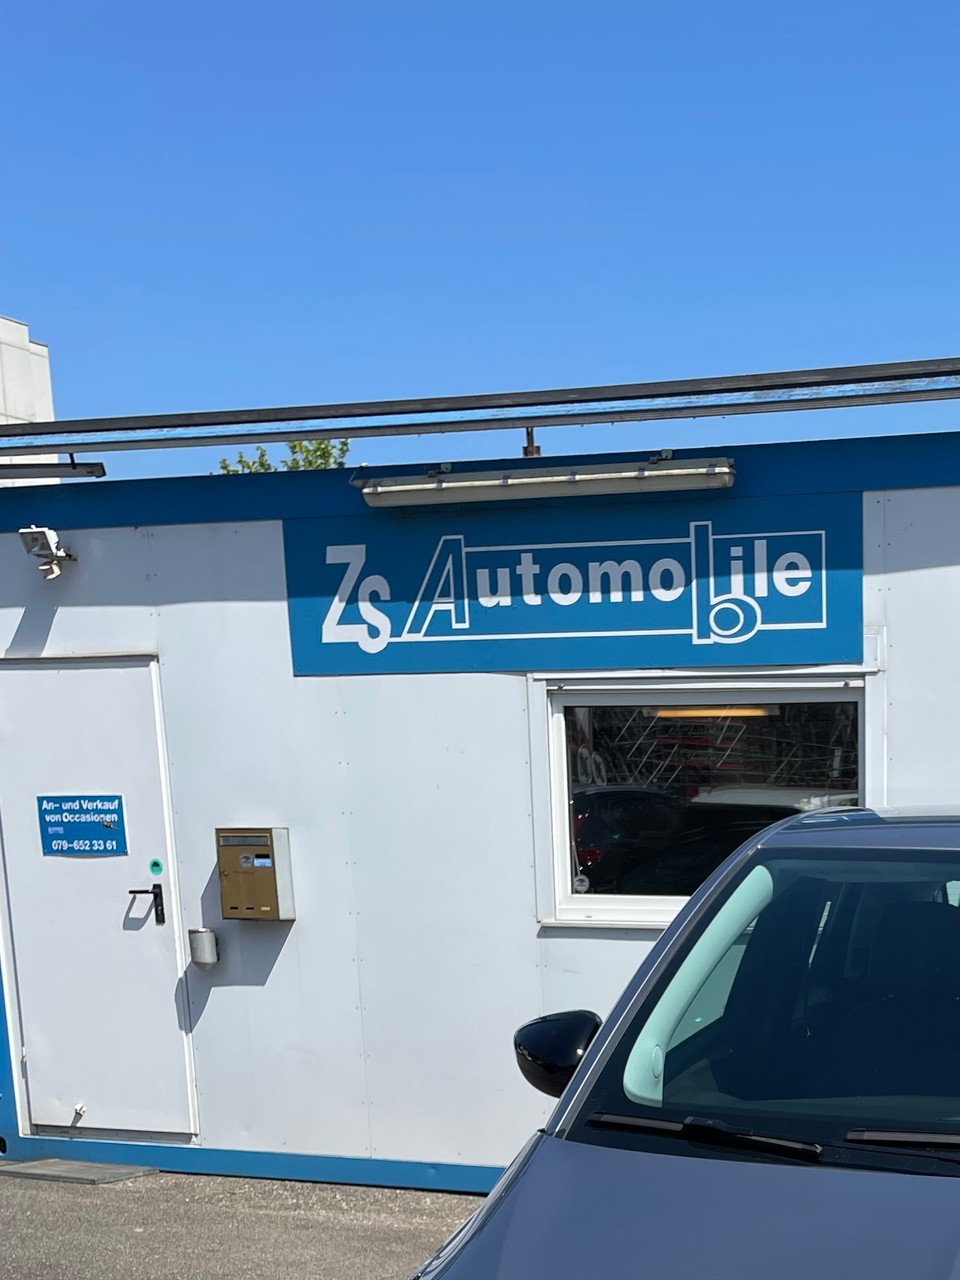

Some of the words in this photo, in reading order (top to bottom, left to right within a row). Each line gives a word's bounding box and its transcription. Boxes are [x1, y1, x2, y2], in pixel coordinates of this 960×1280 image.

[401, 521, 813, 645] Automobile
[42, 799, 60, 811] An-
[61, 800, 80, 811] und
[81, 799, 119, 811] Verkauf
[45, 813, 61, 823] von
[62, 811, 118, 823] Occasionen
[51, 839, 90, 851] 079-652
[92, 840, 105, 850] 33
[106, 839, 117, 850] 61
